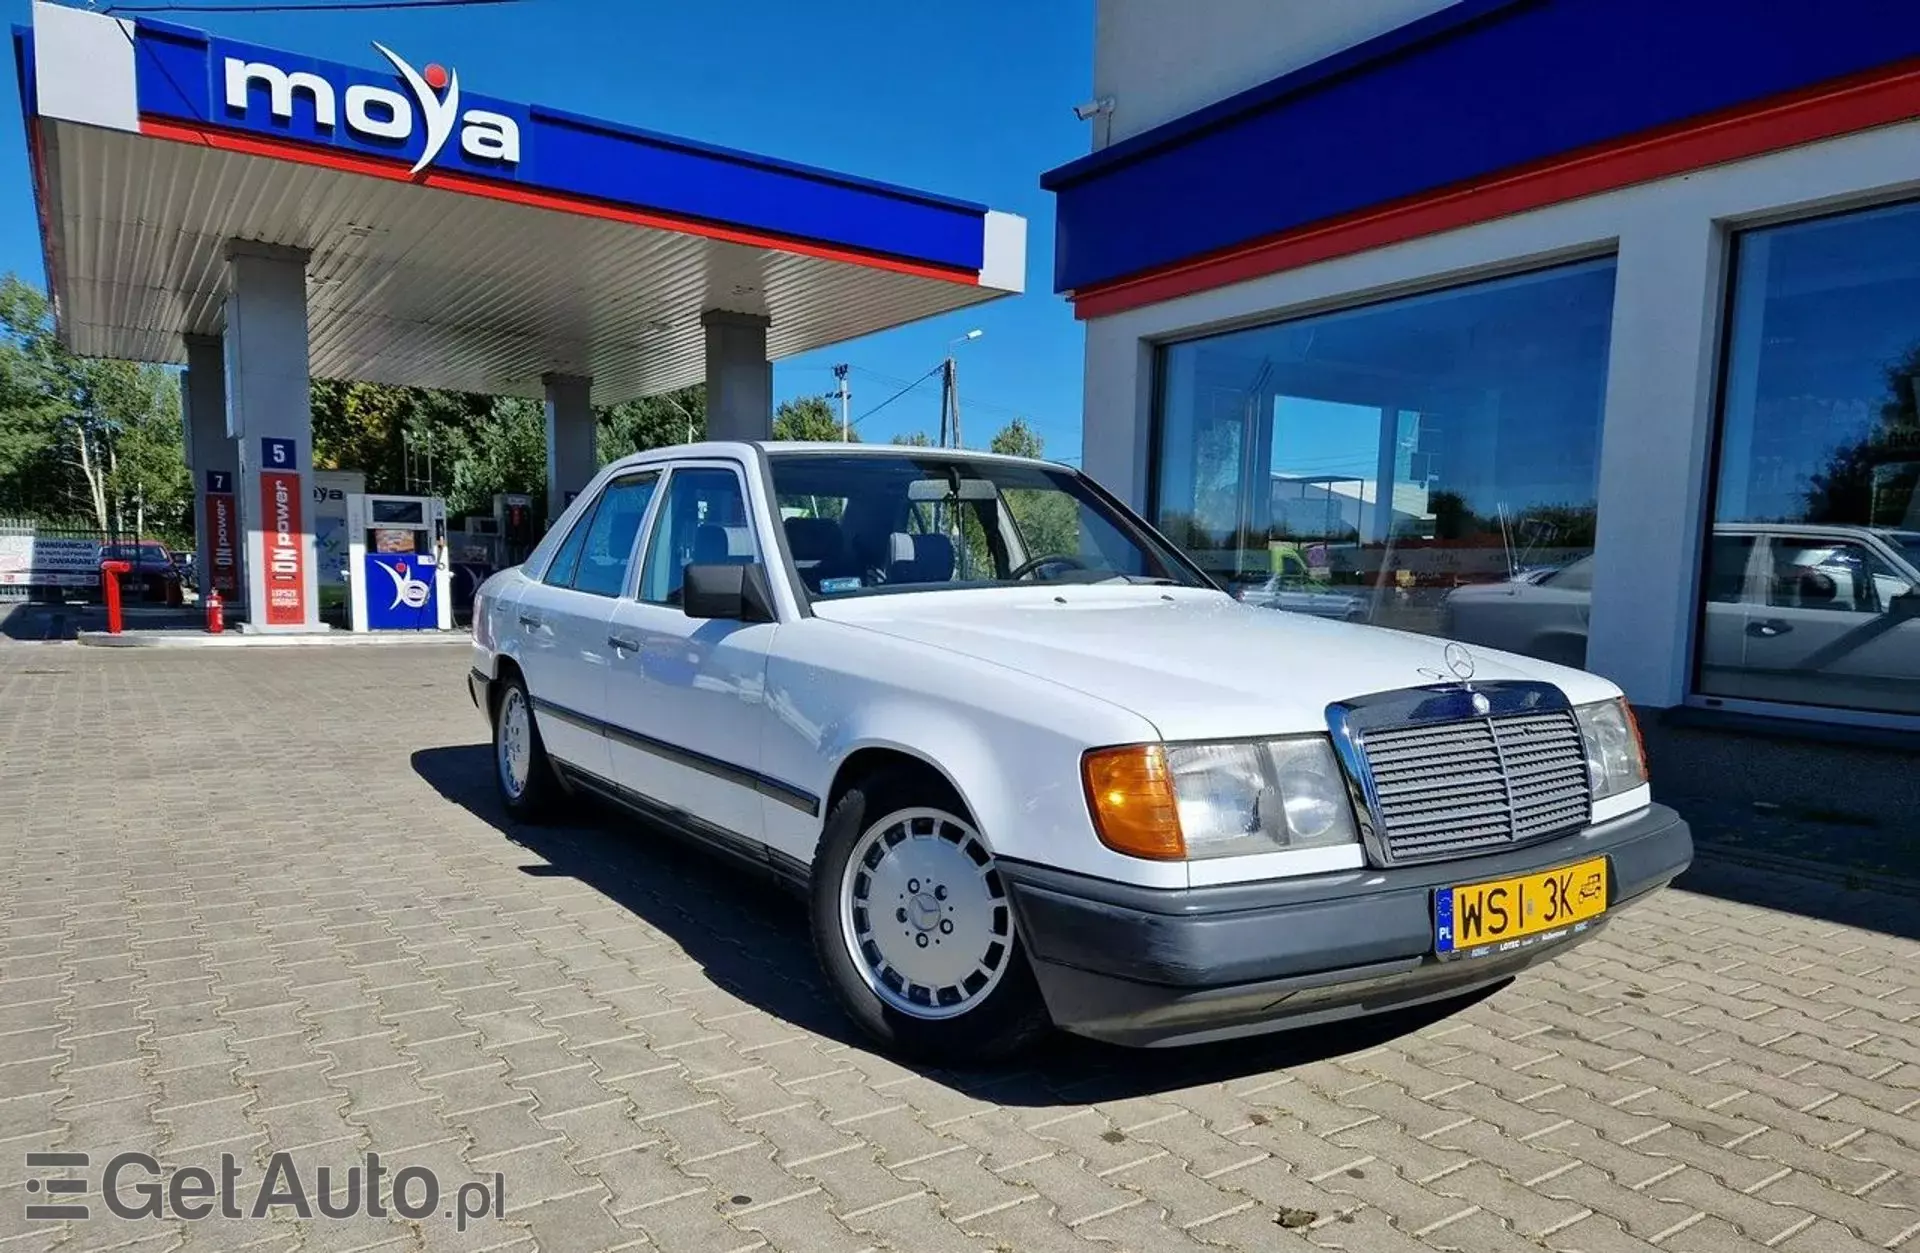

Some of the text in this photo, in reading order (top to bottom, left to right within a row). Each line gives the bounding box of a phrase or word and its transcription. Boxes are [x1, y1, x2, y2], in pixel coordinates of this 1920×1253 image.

[224, 40, 520, 174] moya
[272, 444, 286, 463] 5
[214, 475, 224, 489] 7
[1460, 872, 1574, 941] WSI 3K
[1439, 927, 1452, 941] PL
